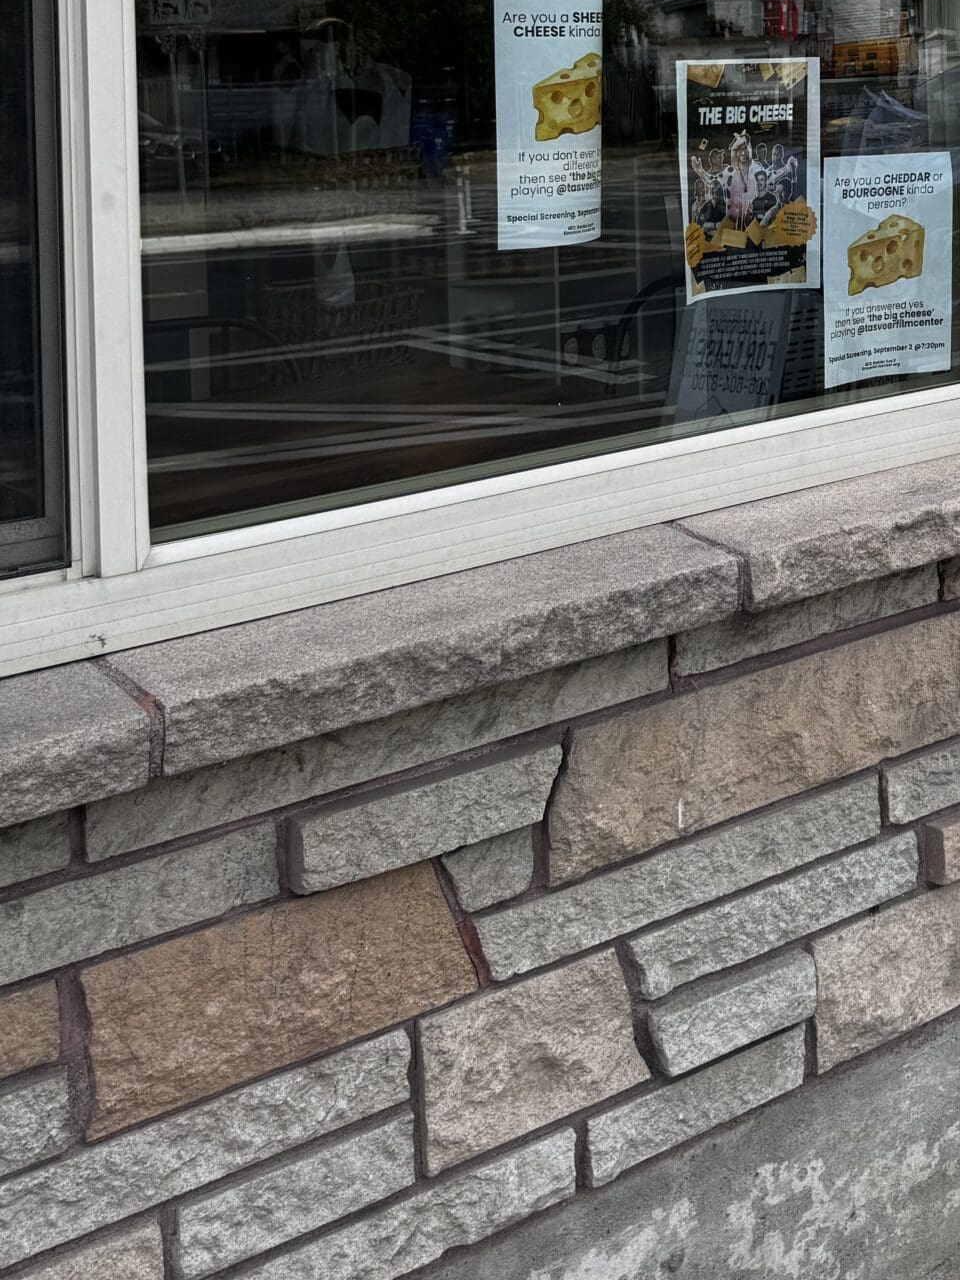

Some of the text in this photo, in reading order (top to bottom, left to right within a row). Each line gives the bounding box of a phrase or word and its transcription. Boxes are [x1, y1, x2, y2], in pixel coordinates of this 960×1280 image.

[502, 11, 527, 23] Are
[531, 13, 556, 26] you
[560, 13, 569, 23] a
[513, 25, 601, 37] CHEESE kinda
[698, 103, 794, 125] THE BIG CHEESE
[518, 152, 525, 162] If
[528, 153, 550, 164] you
[552, 150, 578, 161] don't
[579, 150, 595, 159] even
[519, 174, 546, 184] then
[548, 174, 567, 182] see
[834, 172, 943, 188] Are you a CHEDDAR or
[510, 185, 554, 199] playing
[842, 184, 934, 199] BOURGOGNE kinda
[867, 198, 907, 213] person?
[506, 214, 539, 223] Special
[845, 300, 924, 317] If you answered yes
[834, 318, 851, 328] then
[852, 316, 865, 325] see
[884, 310, 897, 320] big
[830, 317, 944, 341] playing @tasveerfilmcenter
[873, 343, 907, 354] September
